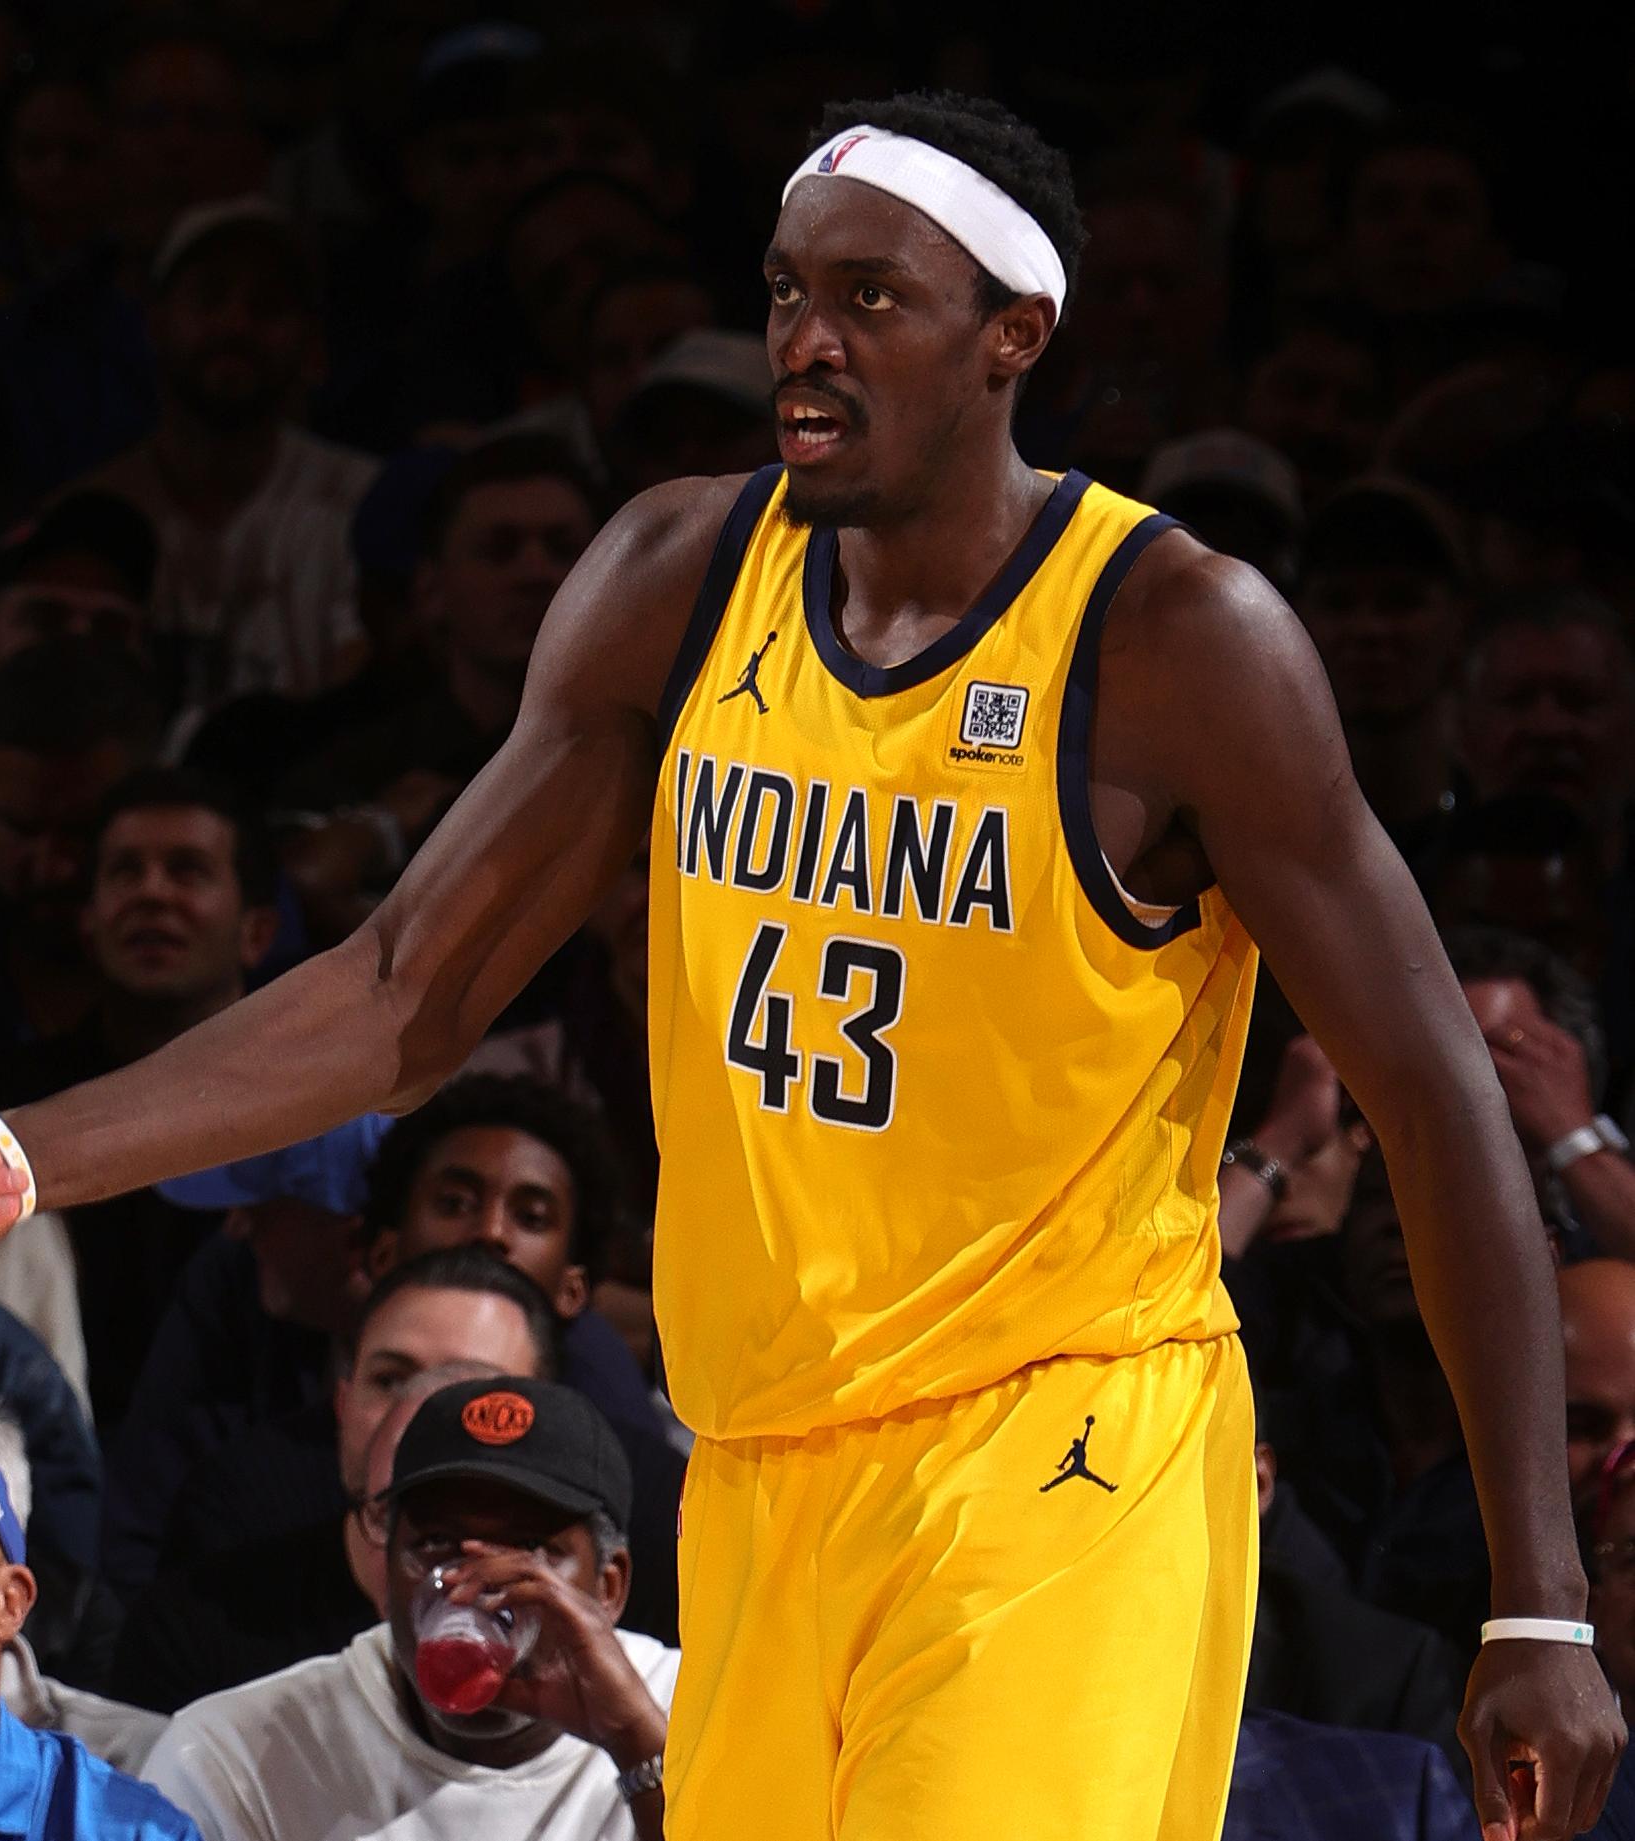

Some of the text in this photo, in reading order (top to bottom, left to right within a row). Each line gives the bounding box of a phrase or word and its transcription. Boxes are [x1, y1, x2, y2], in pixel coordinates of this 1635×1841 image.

[676, 748, 1015, 934] INDIANA
[950, 747, 1024, 766] spokenote
[725, 919, 906, 1134] 43
